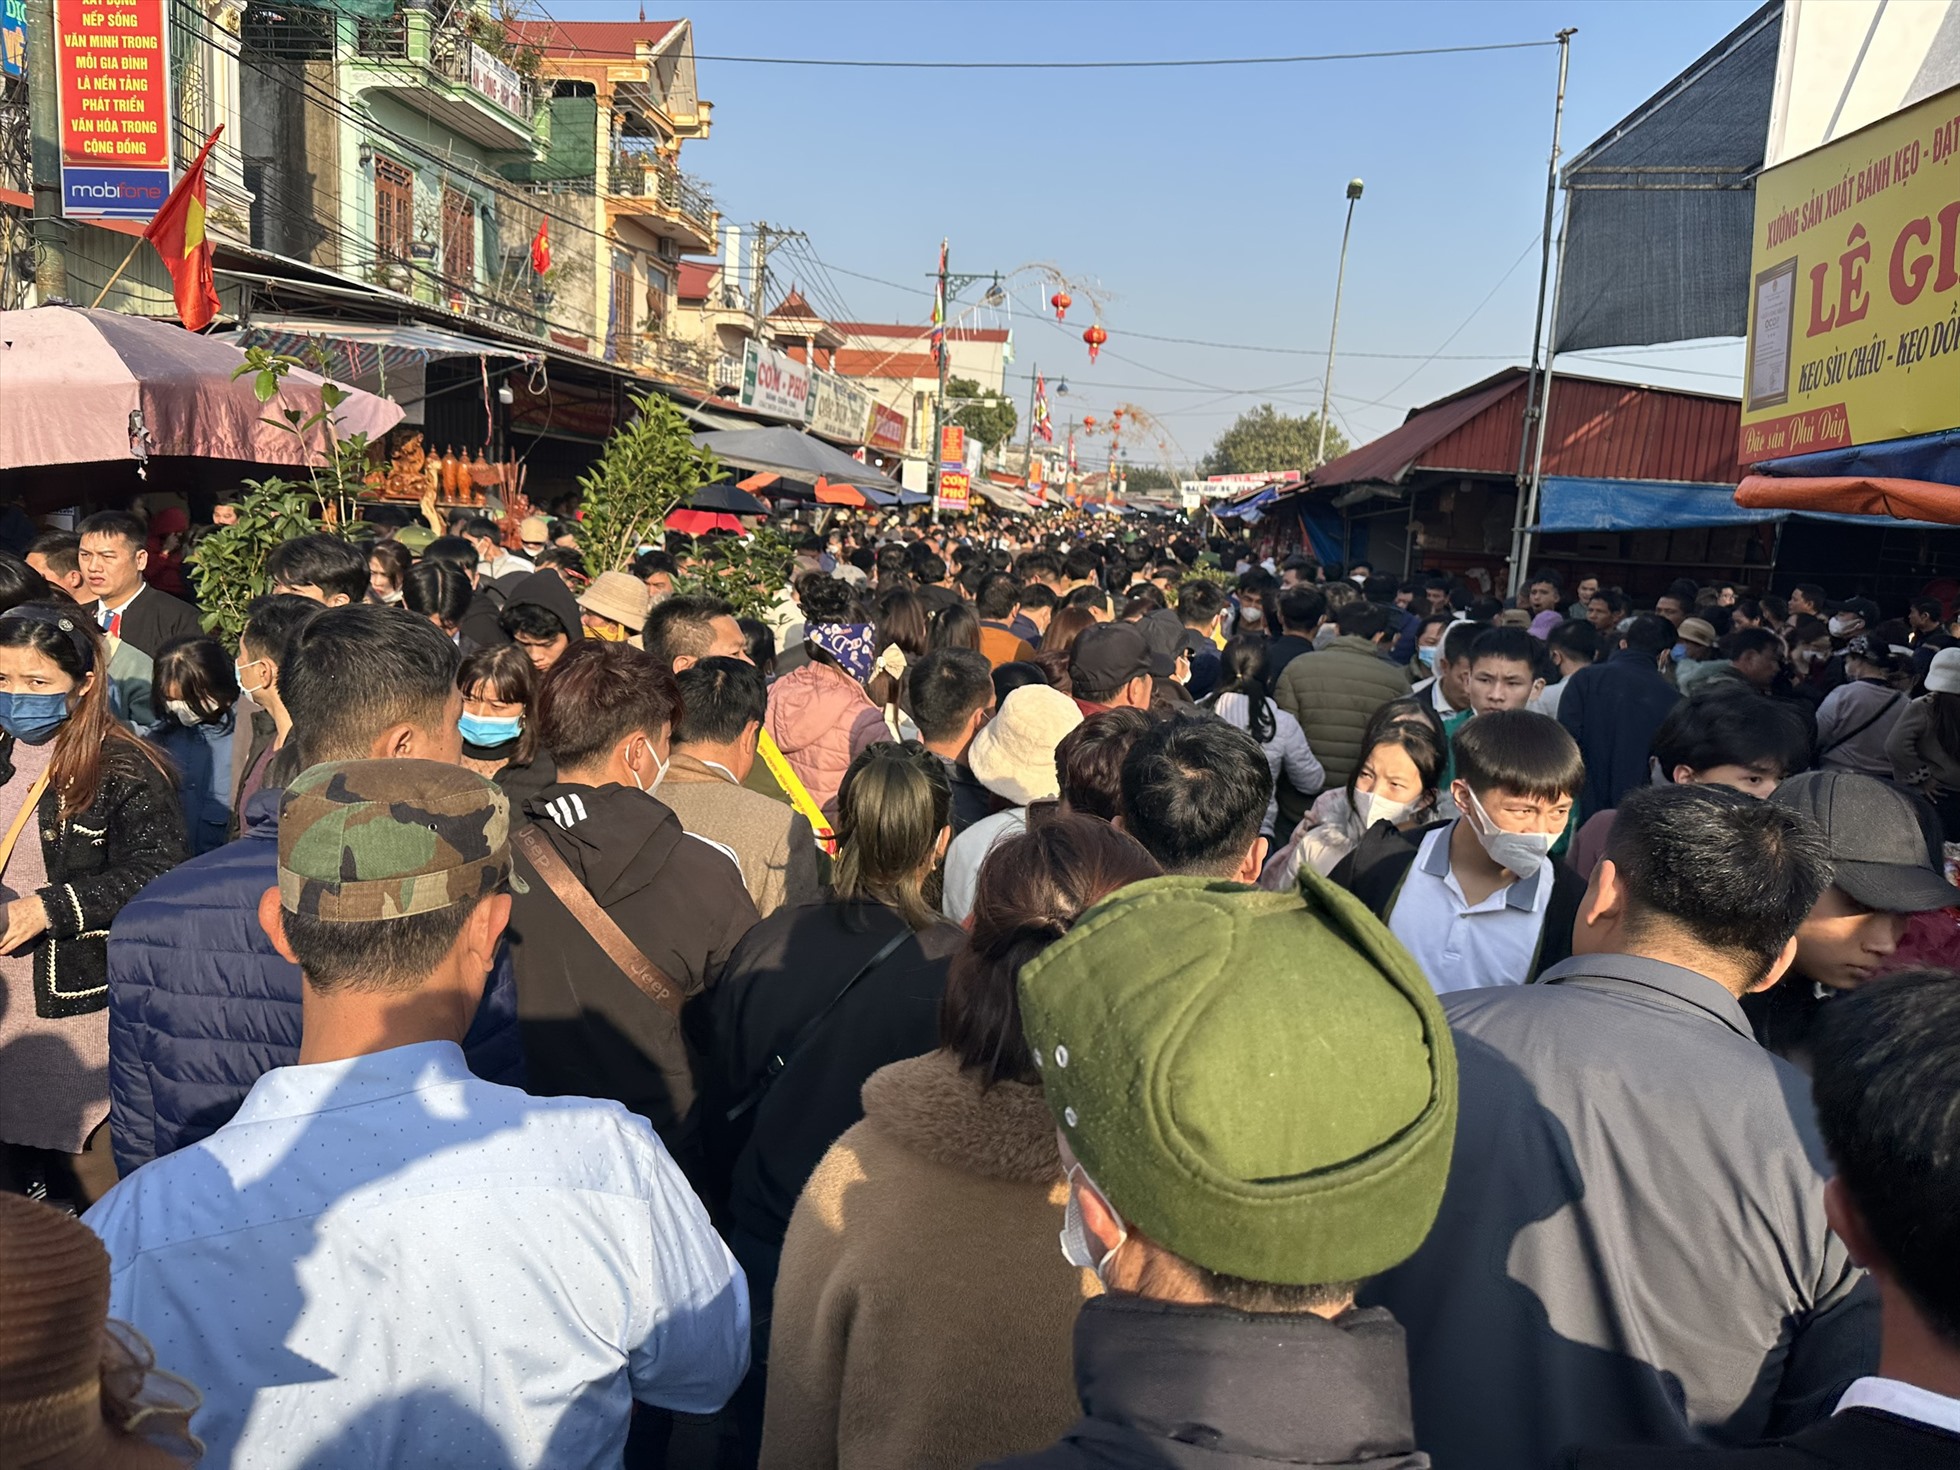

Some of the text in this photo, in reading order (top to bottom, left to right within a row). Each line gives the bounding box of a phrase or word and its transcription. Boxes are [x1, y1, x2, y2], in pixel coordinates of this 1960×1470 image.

[82, 10, 138, 27] NẾP SỐNG
[64, 32, 158, 49] VĂN MINH TRONG
[75, 52, 148, 70] MỖI GIA ĐÌNH
[77, 75, 91, 90] LÀ
[119, 74, 148, 91] TẢNG
[82, 95, 145, 112] PHÁT TRIỂN
[71, 117, 157, 134] VĂN HÓA TRONG
[83, 138, 114, 156] CỘNG
[71, 181, 161, 199] mobifone
[1766, 205, 1799, 250] XƯỞNG
[1801, 188, 1823, 233] SẢN
[1825, 166, 1855, 220] XUẤT
[1856, 160, 1891, 204] BÁNH
[1893, 139, 1920, 187] KẸO
[1806, 200, 1960, 338] LÊ GI
[1798, 359, 1824, 400] KẸO
[1823, 346, 1847, 387] SÌU
[1847, 332, 1887, 380] CHÂU
[1896, 326, 1929, 374] KẸO
[1767, 424, 1785, 450] sản
[1789, 416, 1815, 452] Phủ
[518, 828, 550, 867] Jeep
[630, 963, 670, 1000] Jeep
